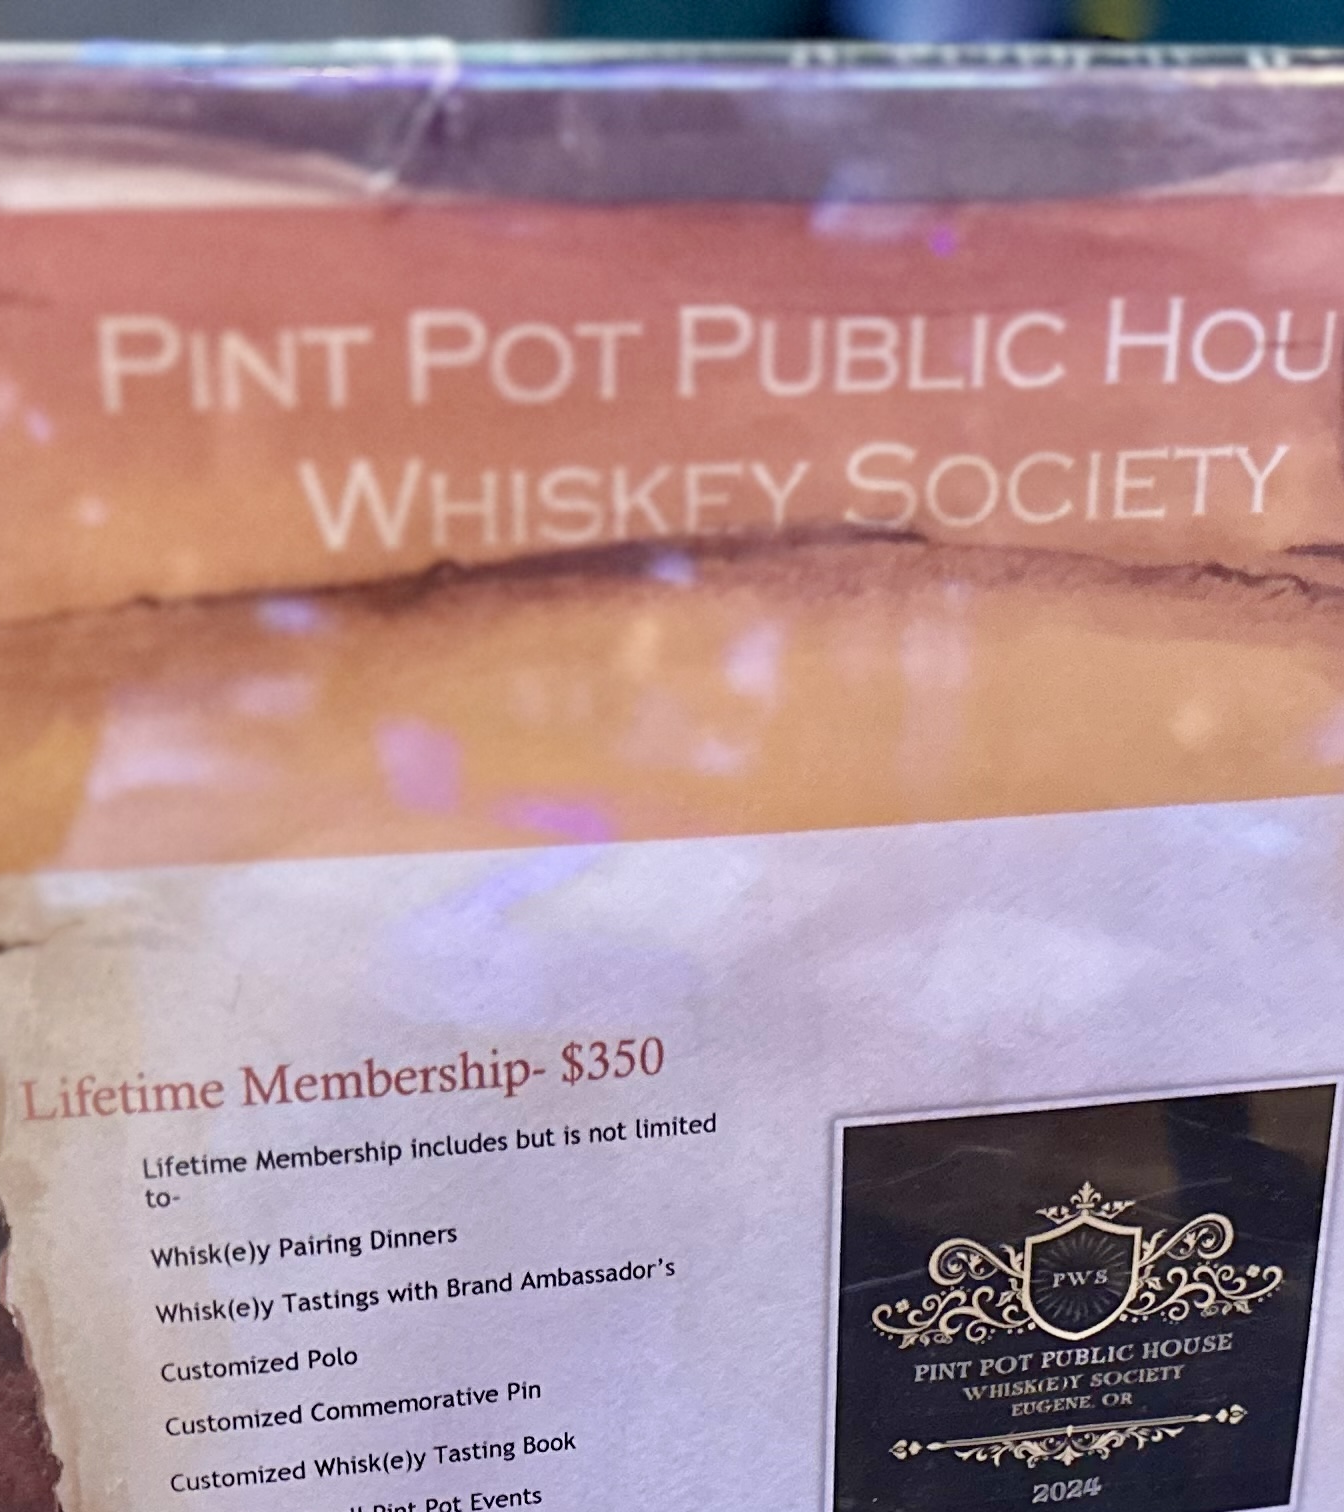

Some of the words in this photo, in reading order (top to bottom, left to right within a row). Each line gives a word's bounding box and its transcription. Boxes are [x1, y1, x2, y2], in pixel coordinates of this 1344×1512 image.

[99, 315, 371, 411] PINT
[409, 307, 642, 404] POT
[676, 302, 1068, 398] PUBLIC
[843, 440, 1290, 528] SOCIETY
[18, 1072, 225, 1122] Lifetime
[240, 1047, 546, 1107] Membership-
[561, 1036, 666, 1086] $350
[142, 1151, 247, 1180] Lifetime
[255, 1140, 403, 1171] Membership
[410, 1130, 508, 1158] includes
[516, 1127, 555, 1150] but
[563, 1124, 581, 1146] is
[588, 1119, 627, 1143] not
[634, 1113, 717, 1140] limited
[145, 1188, 181, 1210] to-
[150, 1239, 271, 1271] Whisk(e)y
[279, 1231, 363, 1260] Pairing
[369, 1225, 458, 1250] Dinners
[156, 1295, 274, 1326] Whisk(e)y
[281, 1286, 380, 1316] Tastings
[387, 1280, 439, 1305] with
[446, 1273, 513, 1299] Brand
[160, 1352, 300, 1384] Customized
[307, 1346, 359, 1369] Polo
[914, 1360, 973, 1382] PINT
[979, 1353, 1034, 1376] POT
[1041, 1345, 1135, 1369] PUBLIC
[1142, 1333, 1233, 1358] HOUSE
[963, 1374, 1083, 1400] WHISK(E)Y
[1090, 1364, 1185, 1387] SOCIETY
[165, 1405, 303, 1438] Customized
[310, 1384, 499, 1423] Commemorative
[507, 1379, 542, 1400] Pin
[1101, 1392, 1133, 1407] OR
[170, 1461, 306, 1493] Customized
[315, 1448, 427, 1480] Whisk(e)y
[433, 1440, 516, 1468] Tasting
[523, 1432, 577, 1455] Book
[470, 1487, 542, 1511] Events
[1031, 1476, 1102, 1504] 2024
